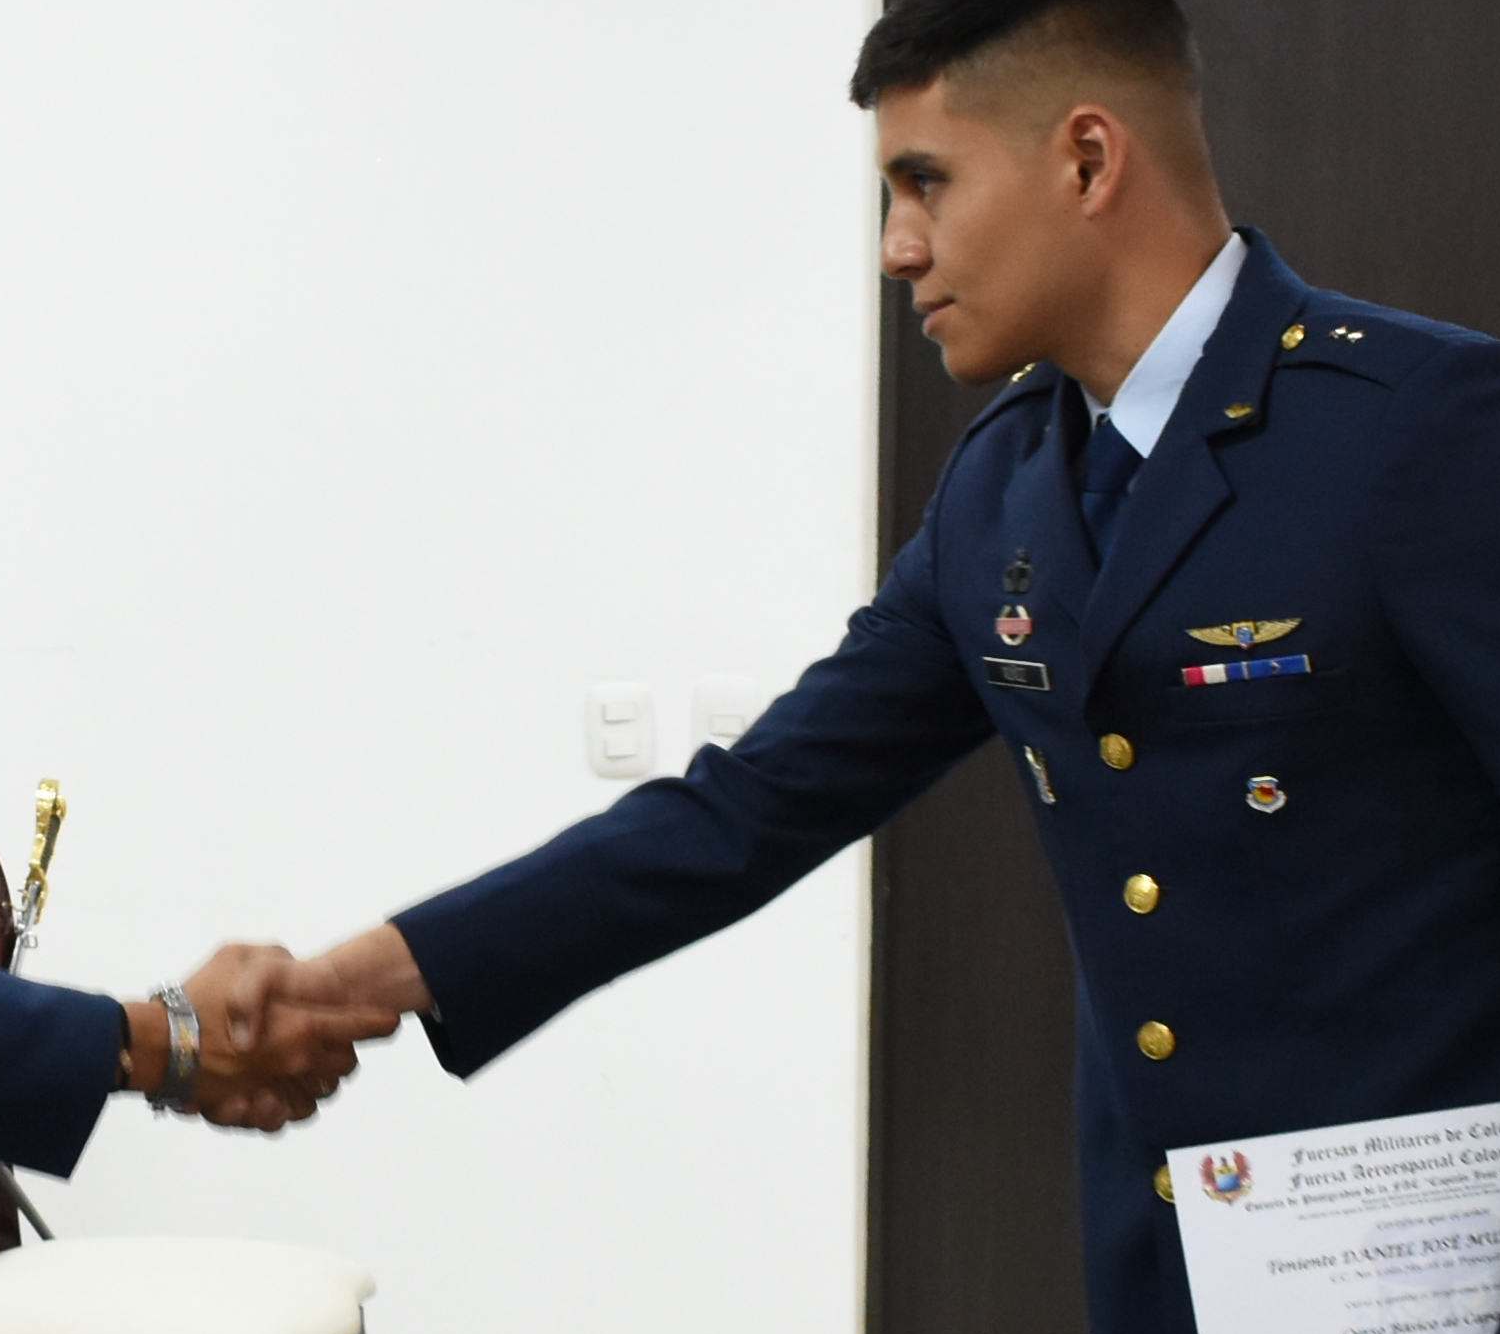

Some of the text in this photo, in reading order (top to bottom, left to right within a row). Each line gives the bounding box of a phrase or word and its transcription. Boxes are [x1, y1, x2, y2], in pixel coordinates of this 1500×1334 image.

[1365, 1130, 1440, 1153] Militares
[1445, 1127, 1463, 1141] de
[1268, 1253, 1337, 1274] Teniente
[1342, 1242, 1416, 1264] DANIEL
